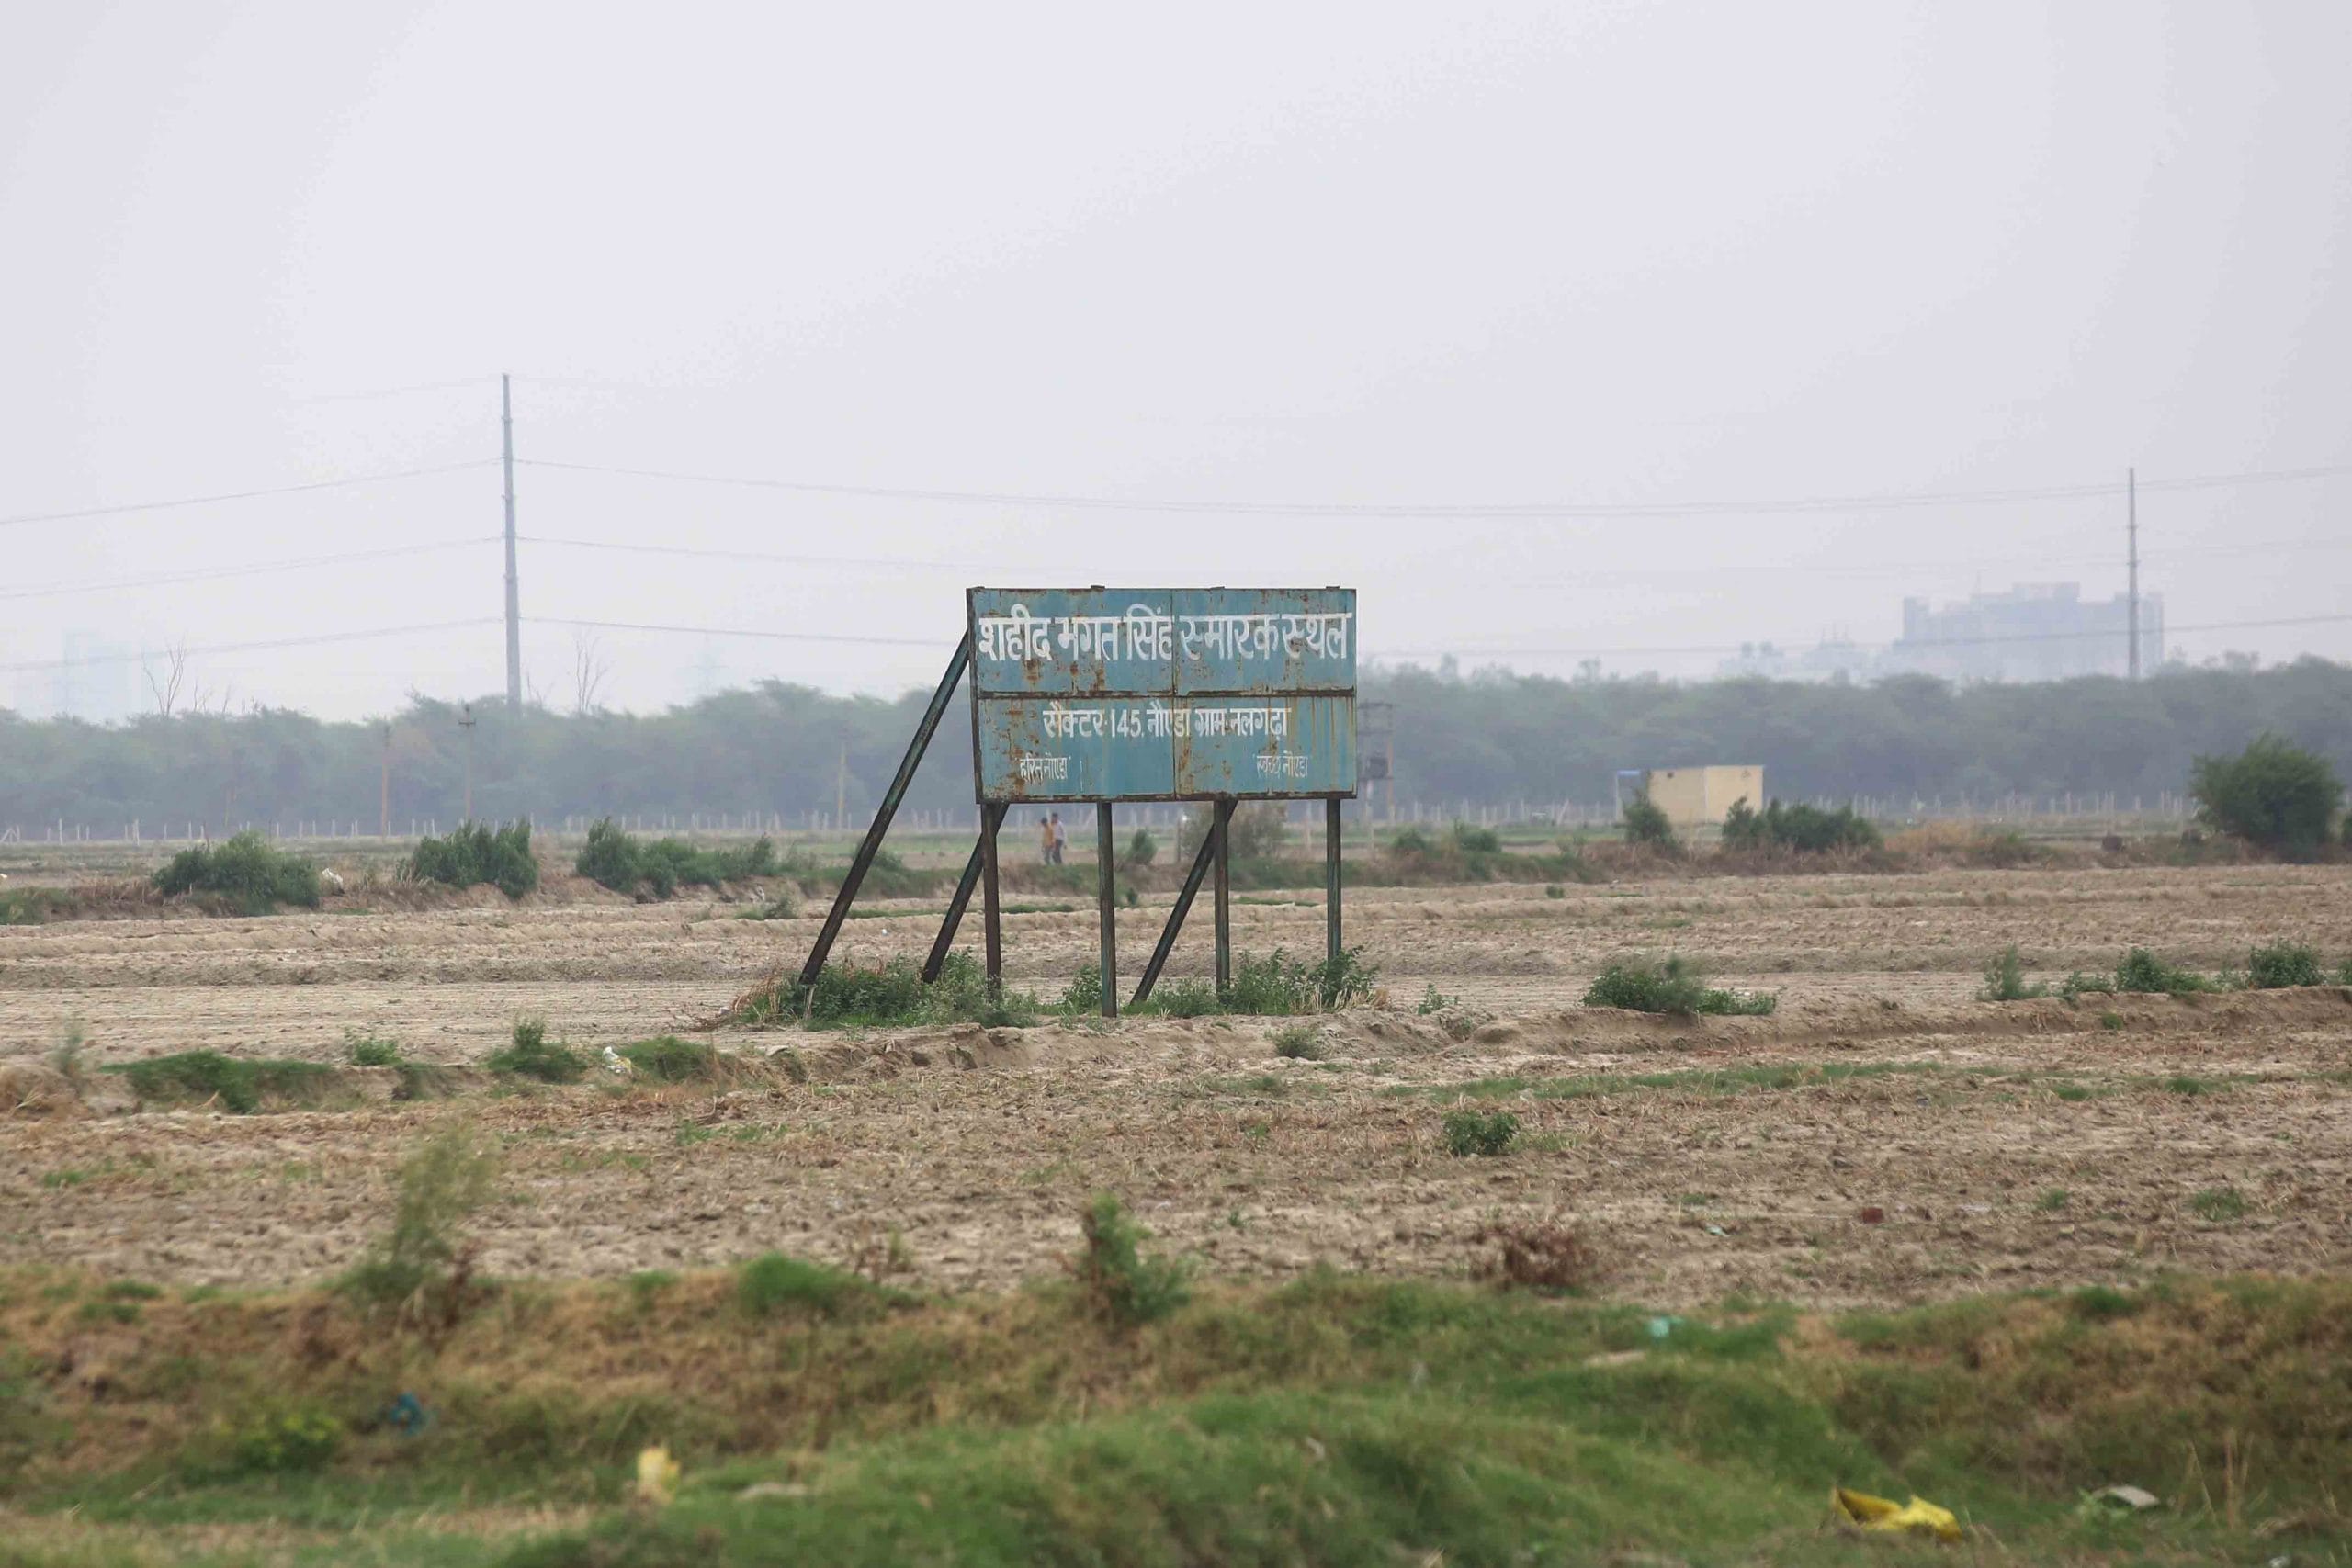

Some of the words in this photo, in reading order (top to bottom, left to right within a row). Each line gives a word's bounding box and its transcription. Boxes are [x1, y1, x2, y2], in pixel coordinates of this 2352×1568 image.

[978, 604, 1053, 660] शहीद
[1055, 615, 1122, 660] भगत
[1123, 604, 1175, 660] सिंह
[1178, 614, 1280, 660] स्मारक
[1281, 612, 1353, 660] स्थल
